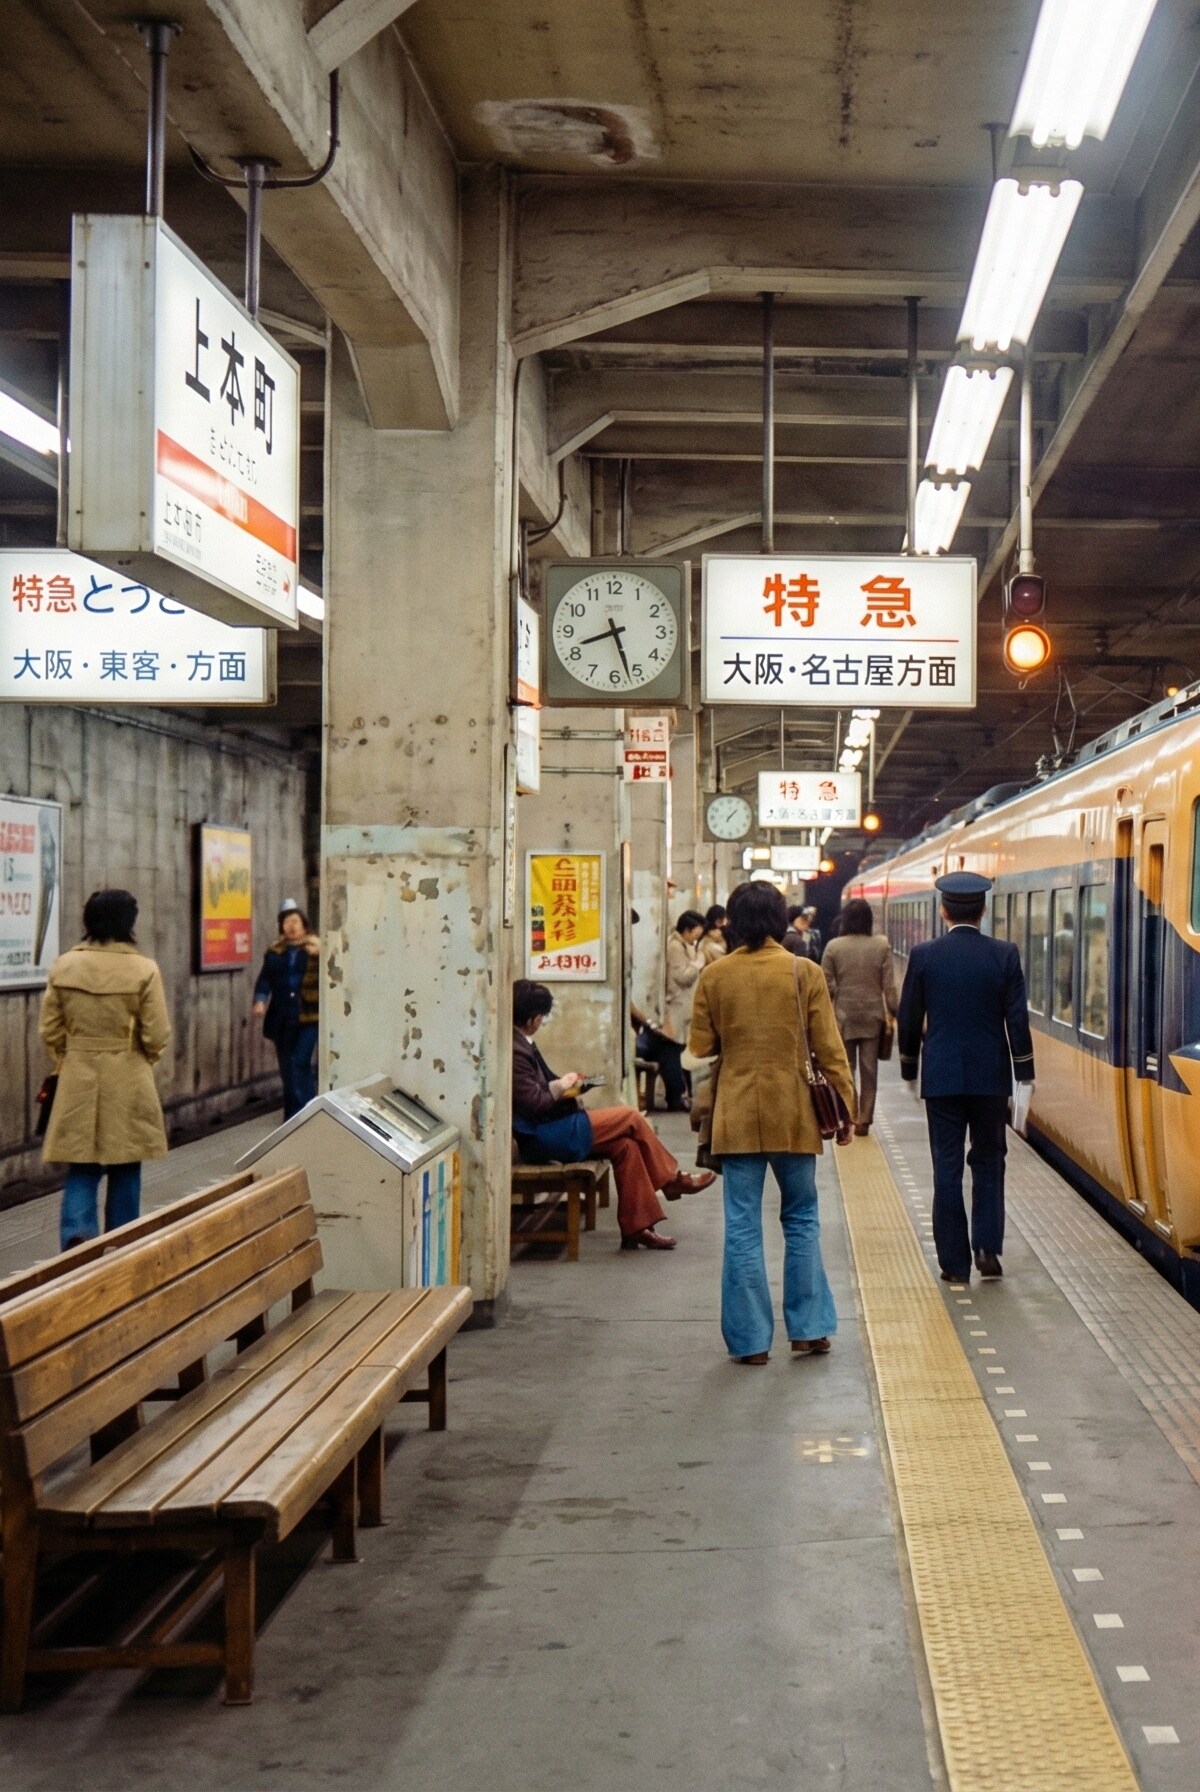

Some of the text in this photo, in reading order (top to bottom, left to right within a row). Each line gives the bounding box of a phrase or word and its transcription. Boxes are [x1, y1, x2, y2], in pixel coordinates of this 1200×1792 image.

[185, 297, 276, 456] 上本町
[587, 588, 599, 601] 11
[606, 580, 623, 595] 12
[635, 587, 640, 601] 1
[762, 573, 917, 629] 特急
[569, 603, 586, 617] 10
[649, 604, 660, 618] 2
[562, 624, 574, 638] 9
[655, 625, 667, 639] 3
[569, 646, 582, 661] 8
[648, 648, 659, 661] 4
[13, 648, 247, 682] 大阪・東客・方面
[587, 664, 598, 678] 7
[631, 664, 643, 677] 5
[723, 652, 957, 687] 大阪・名古屋方面
[609, 670, 621, 684] 6
